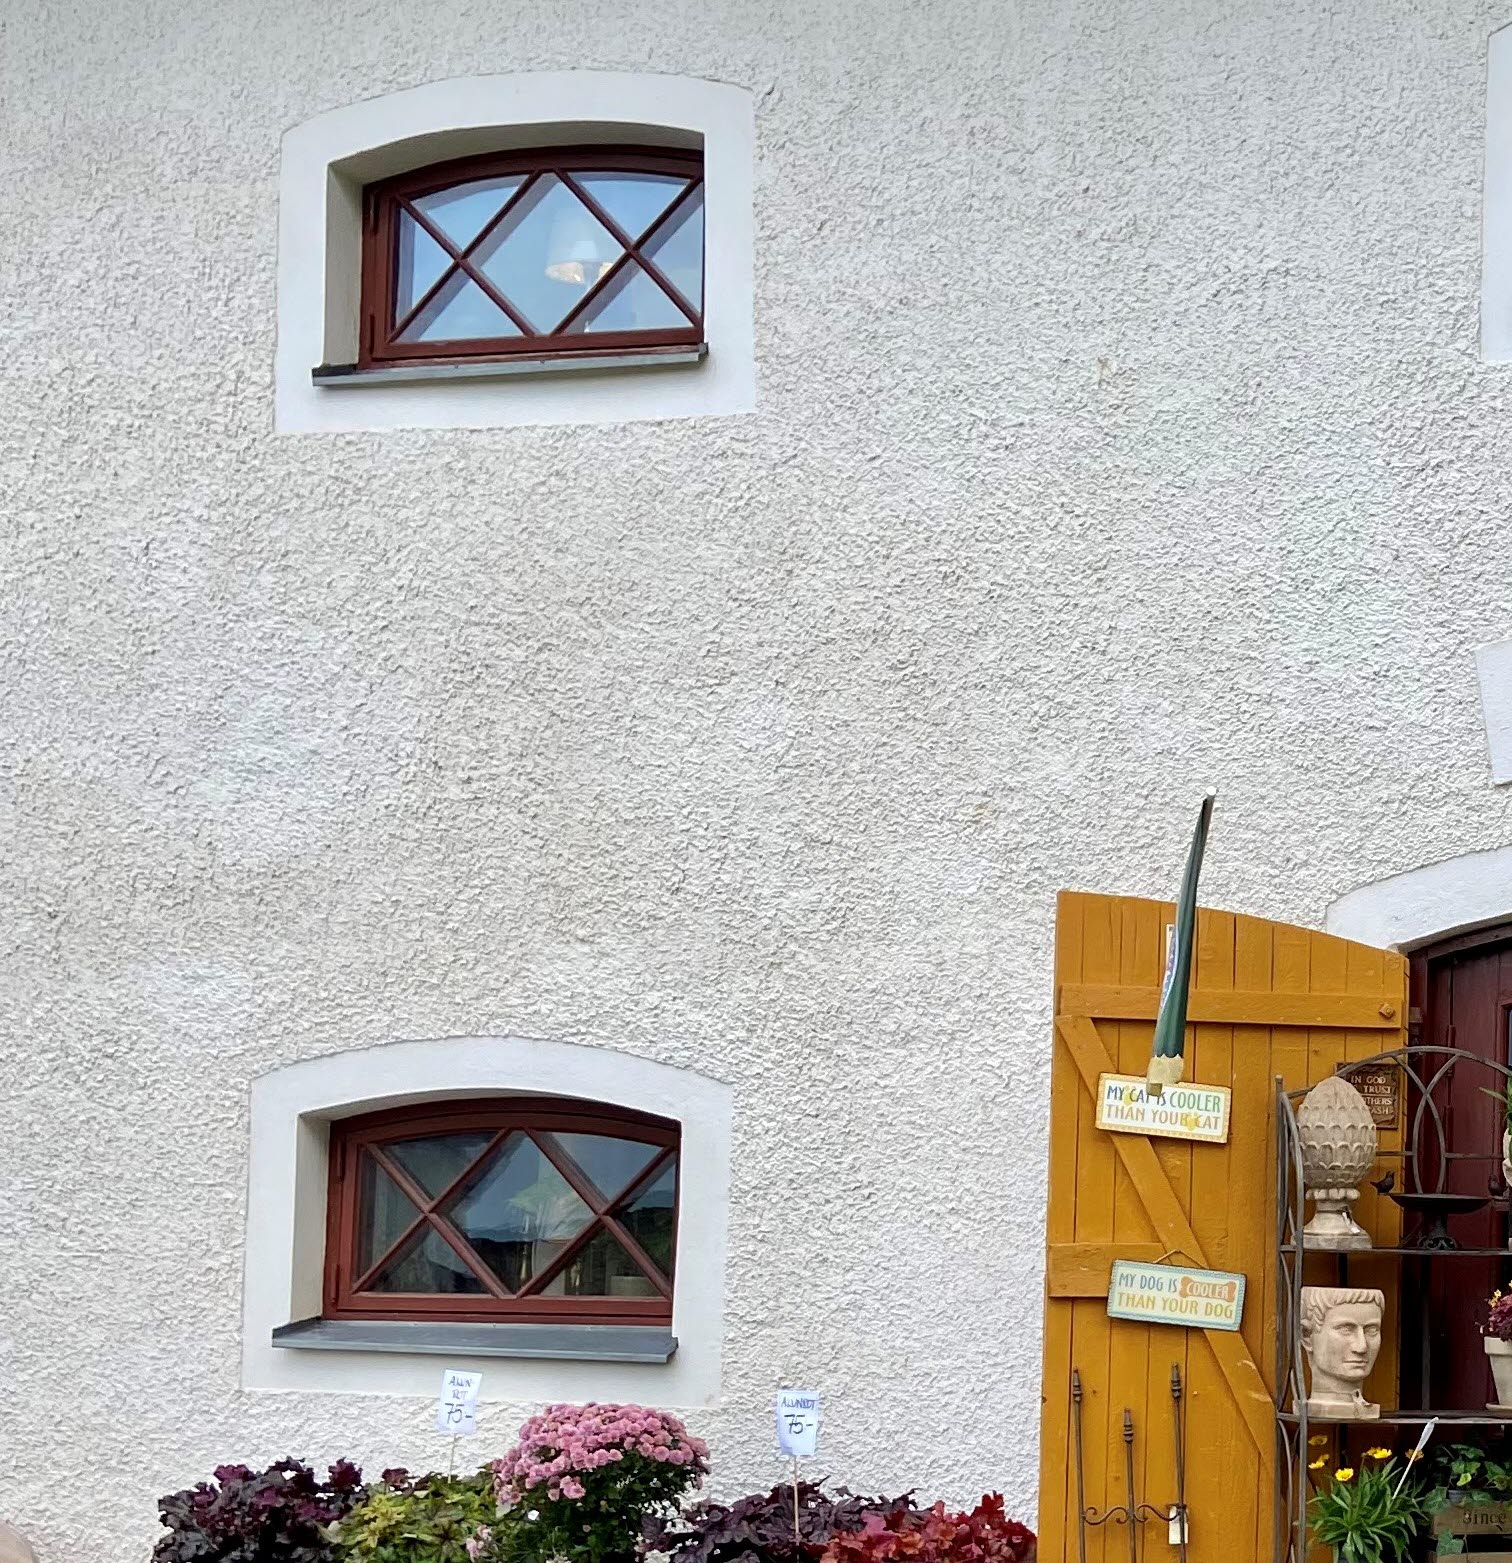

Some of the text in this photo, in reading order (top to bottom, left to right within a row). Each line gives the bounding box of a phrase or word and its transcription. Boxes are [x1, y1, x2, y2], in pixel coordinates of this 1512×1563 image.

[1363, 1086, 1391, 1094] TRUST
[1366, 1076, 1386, 1084] GOD
[1107, 1086, 1124, 1101] MY
[1170, 1091, 1221, 1113] COOLER
[1363, 1097, 1393, 1105] THERS
[1105, 1104, 1220, 1130] THAN YOUR CAT
[1118, 1273, 1229, 1299] MY DOG IS COOLER
[1117, 1292, 1233, 1319] THAN YOUR DOG
